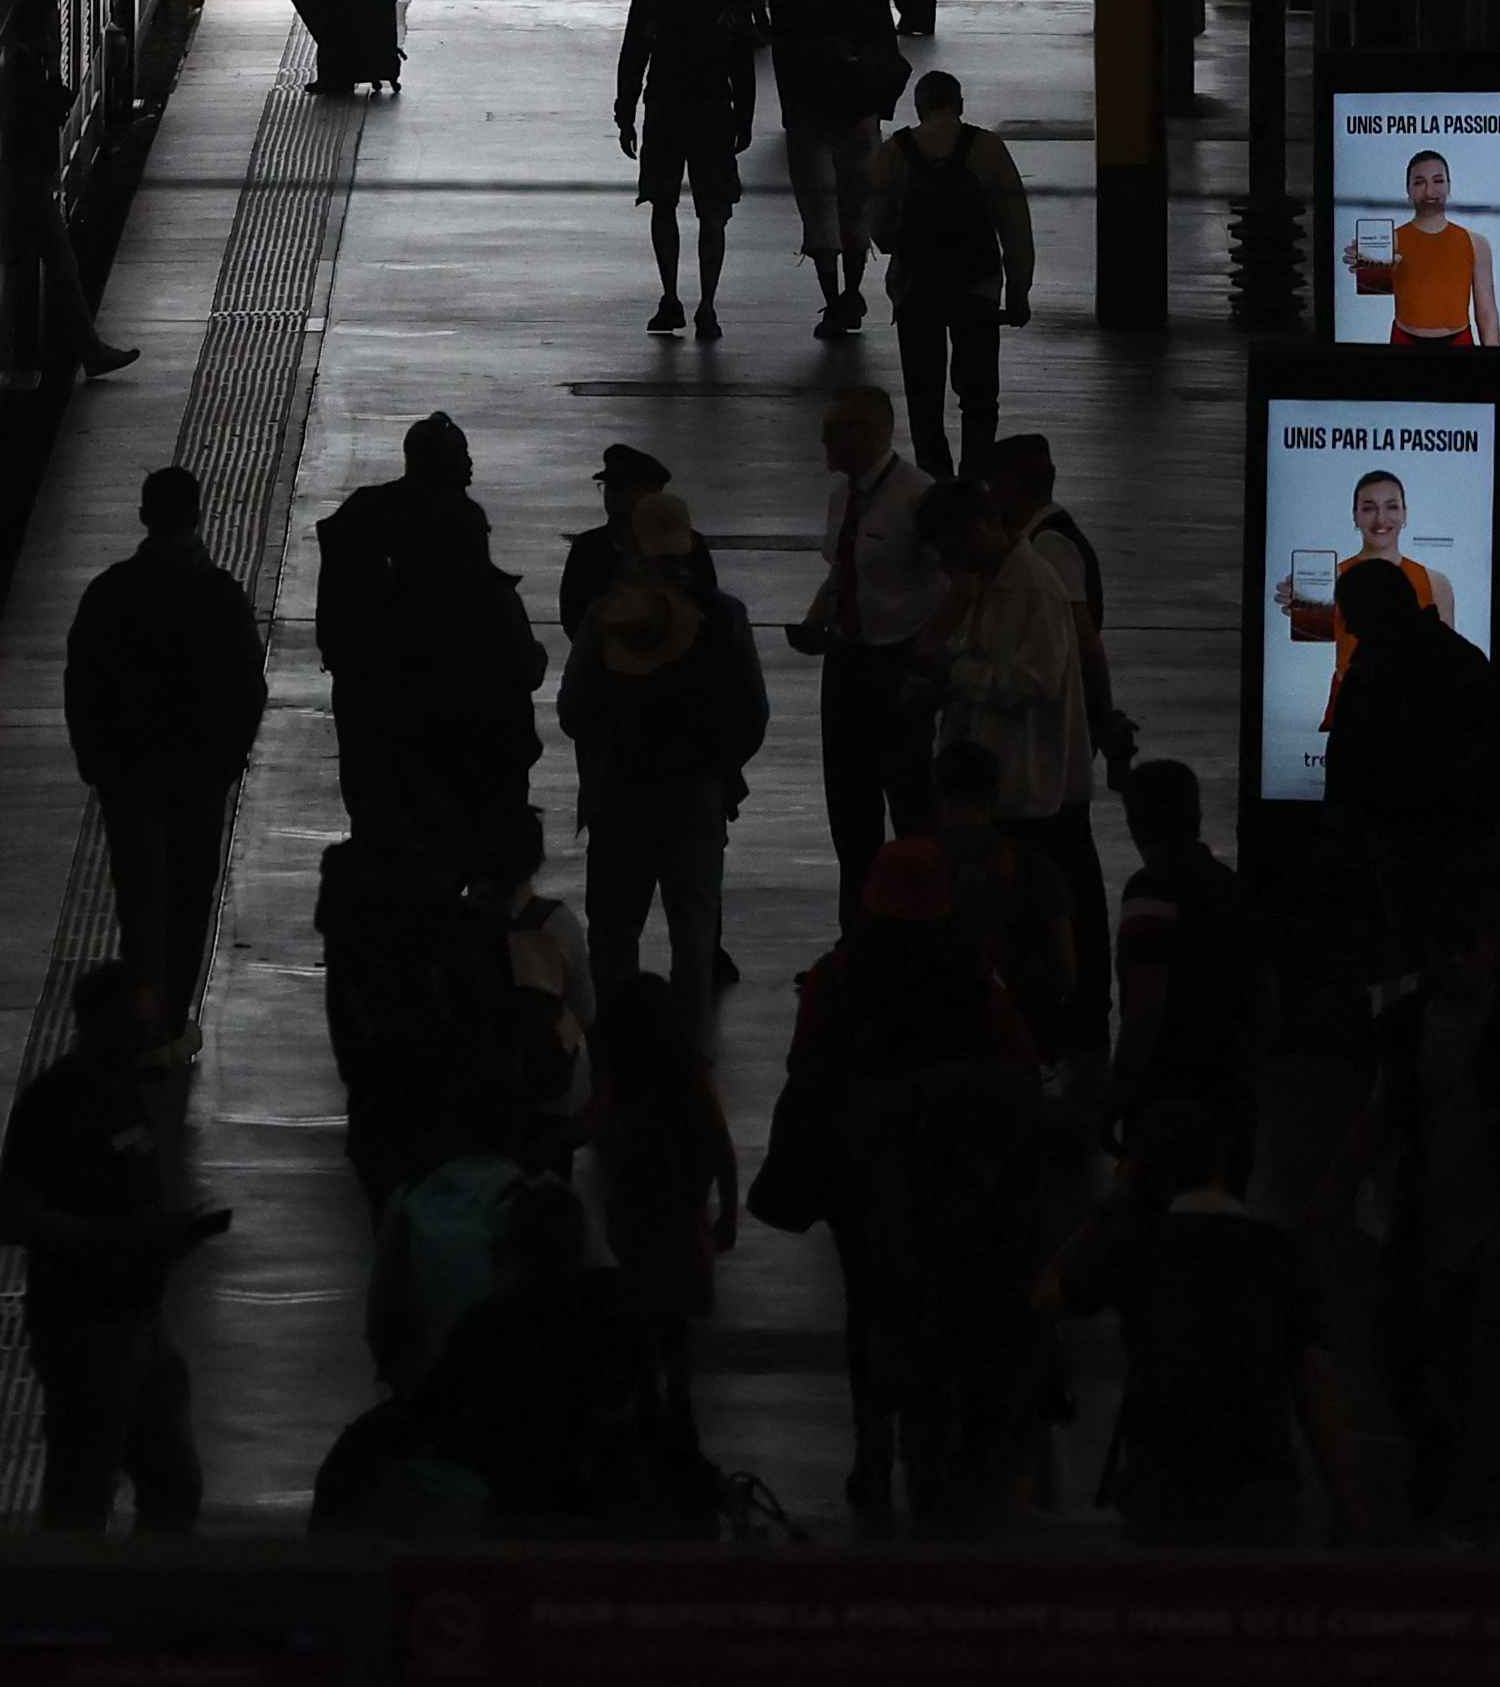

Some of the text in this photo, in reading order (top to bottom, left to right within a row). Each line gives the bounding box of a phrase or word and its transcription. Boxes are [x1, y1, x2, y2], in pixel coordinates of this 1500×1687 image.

[1346, 115, 1383, 135] UNIS
[1387, 115, 1418, 135] PAR
[1421, 115, 1441, 135] LA
[1284, 426, 1478, 453] UNIS PAR LA PASSION
